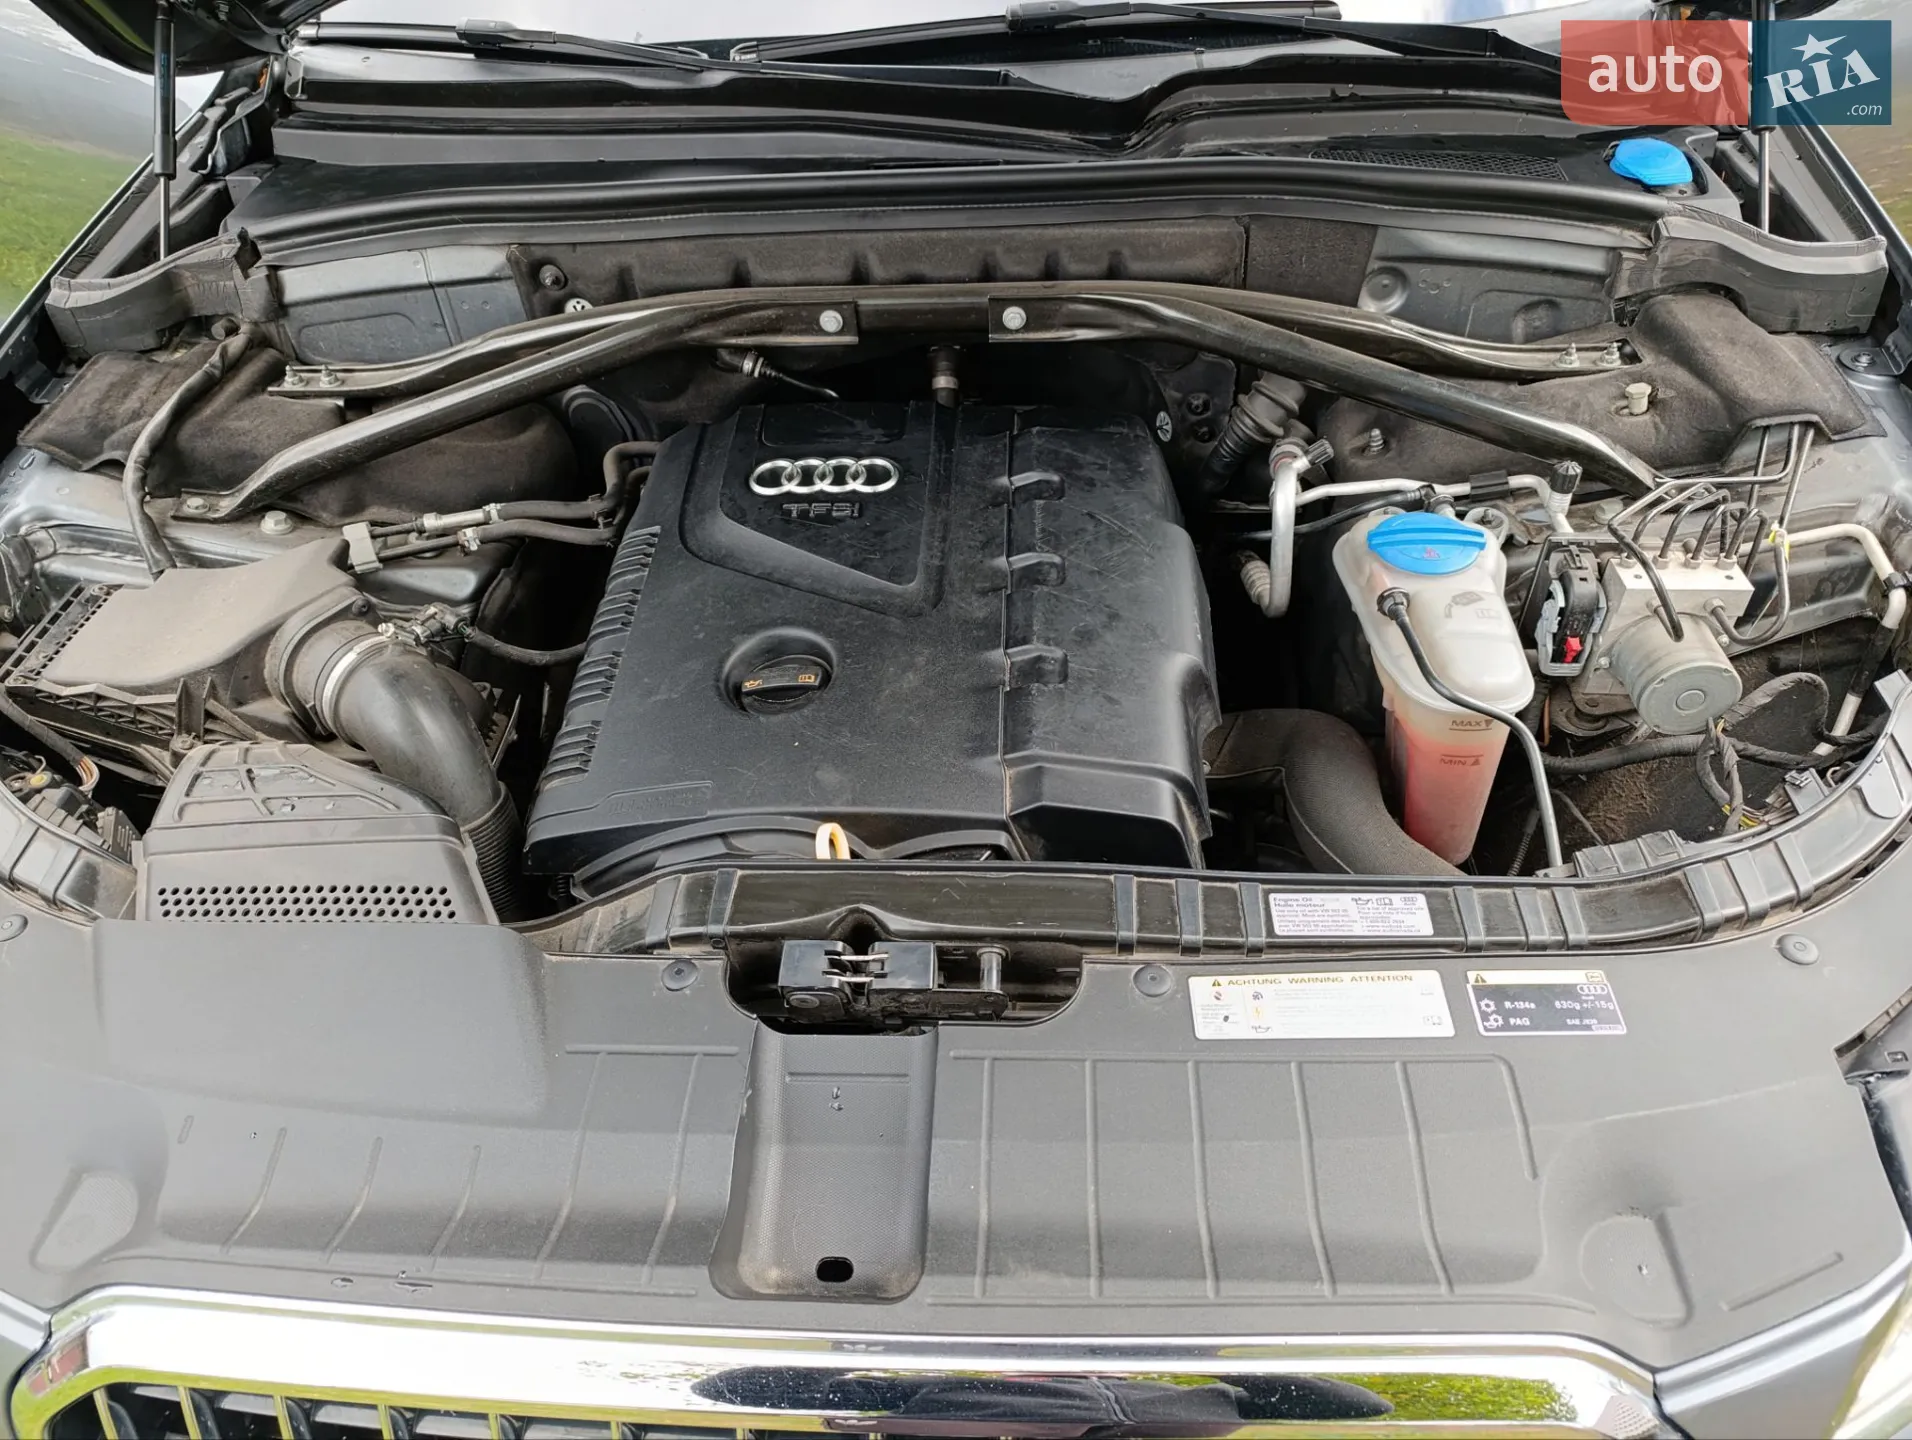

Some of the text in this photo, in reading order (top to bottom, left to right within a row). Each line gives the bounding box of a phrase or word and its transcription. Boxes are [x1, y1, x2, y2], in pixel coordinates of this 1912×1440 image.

[782, 502, 861, 518] TFSI
[1451, 719, 1482, 728] MAX
[1439, 757, 1467, 766] MIN
[1227, 975, 1413, 986] ACHTUNG WARNING ATTENTION
[1509, 1017, 1530, 1026] PAG
